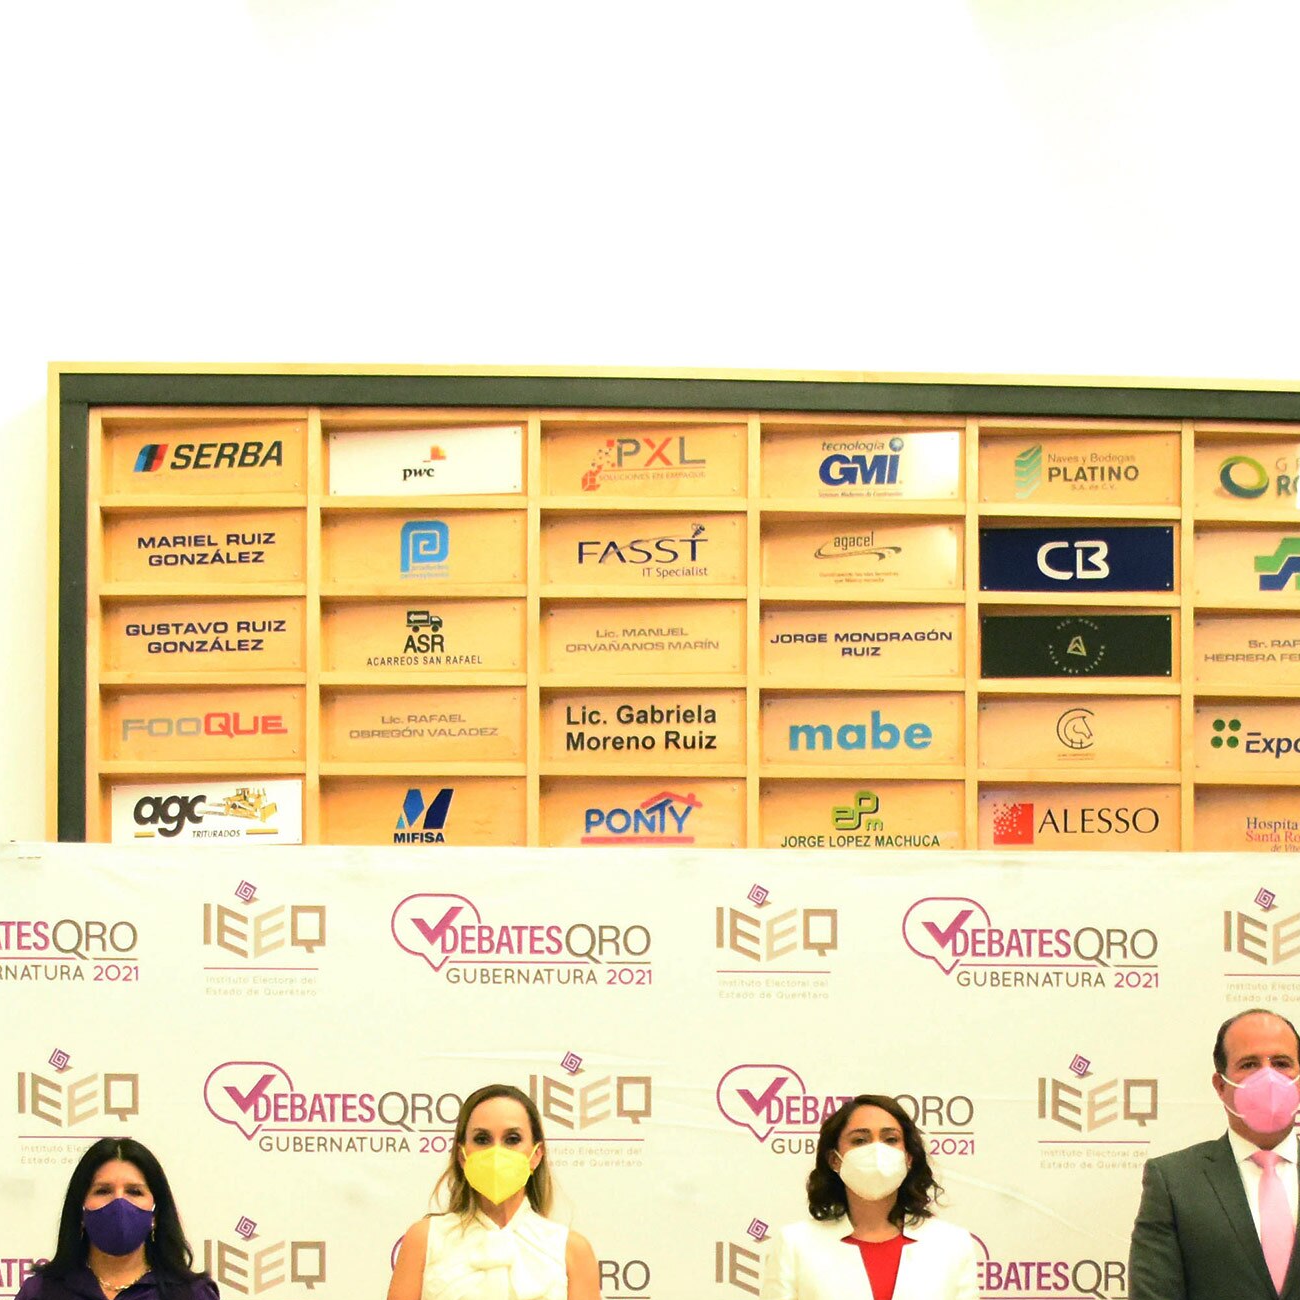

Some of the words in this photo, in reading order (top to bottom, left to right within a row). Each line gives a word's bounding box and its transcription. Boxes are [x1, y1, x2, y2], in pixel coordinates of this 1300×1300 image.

[170, 440, 283, 470] SERBA
[617, 436, 706, 467] PXL
[1048, 453, 1078, 463] Naves
[1090, 452, 1136, 463] Bodegas
[403, 466, 435, 482] pwc
[1048, 466, 1139, 483] PLATINO
[137, 534, 218, 550] MARIEL
[226, 532, 276, 546] RUIZ
[834, 532, 875, 549] agacel
[148, 550, 265, 567] GONZÁLEZ
[578, 537, 709, 565] FASST
[1037, 540, 1110, 581] CB
[642, 568, 653, 577] IT
[656, 566, 709, 578] Specialist
[126, 621, 229, 637] GUSTAVO
[237, 620, 286, 634] RUIZ
[622, 628, 689, 638] MANUEL
[770, 632, 827, 644] JORGE
[834, 628, 953, 643] MONDRAGÓN
[148, 637, 264, 654] GONZÁLEZ
[404, 635, 444, 653] ASR
[566, 640, 665, 653] ORVAÑANOS
[668, 640, 720, 651] MARÍN
[841, 647, 881, 657] RUIZ
[367, 657, 419, 667] ACARREOS
[423, 656, 442, 665] SAN
[445, 655, 482, 665] RAFAEL
[1204, 653, 1277, 663] HERRERA
[407, 714, 466, 724] RAFAEL
[567, 706, 607, 726] Lic.
[616, 705, 717, 725] Gabriela
[349, 725, 424, 739] OBREGÓN
[427, 727, 499, 738] VALADEZ
[789, 711, 933, 751] mabe
[566, 731, 656, 751] Moreno
[664, 730, 717, 750] Ruiz
[134, 794, 206, 837] agc
[585, 799, 693, 834] PONTY
[1038, 808, 1159, 835] ALESSO
[192, 829, 240, 838] TRITURADOS
[394, 833, 445, 844] MIFISA
[781, 835, 825, 849] JORGE
[829, 835, 871, 848] LOPEZ
[875, 835, 941, 848] MACHUCA
[1246, 830, 1280, 842] Santa
[204, 903, 326, 959] IEEQ
[93, 964, 140, 982] 2021
[446, 968, 598, 986] GUBERNATURA
[606, 968, 653, 986] 2021
[1038, 1076, 1159, 1134] IEEQ
